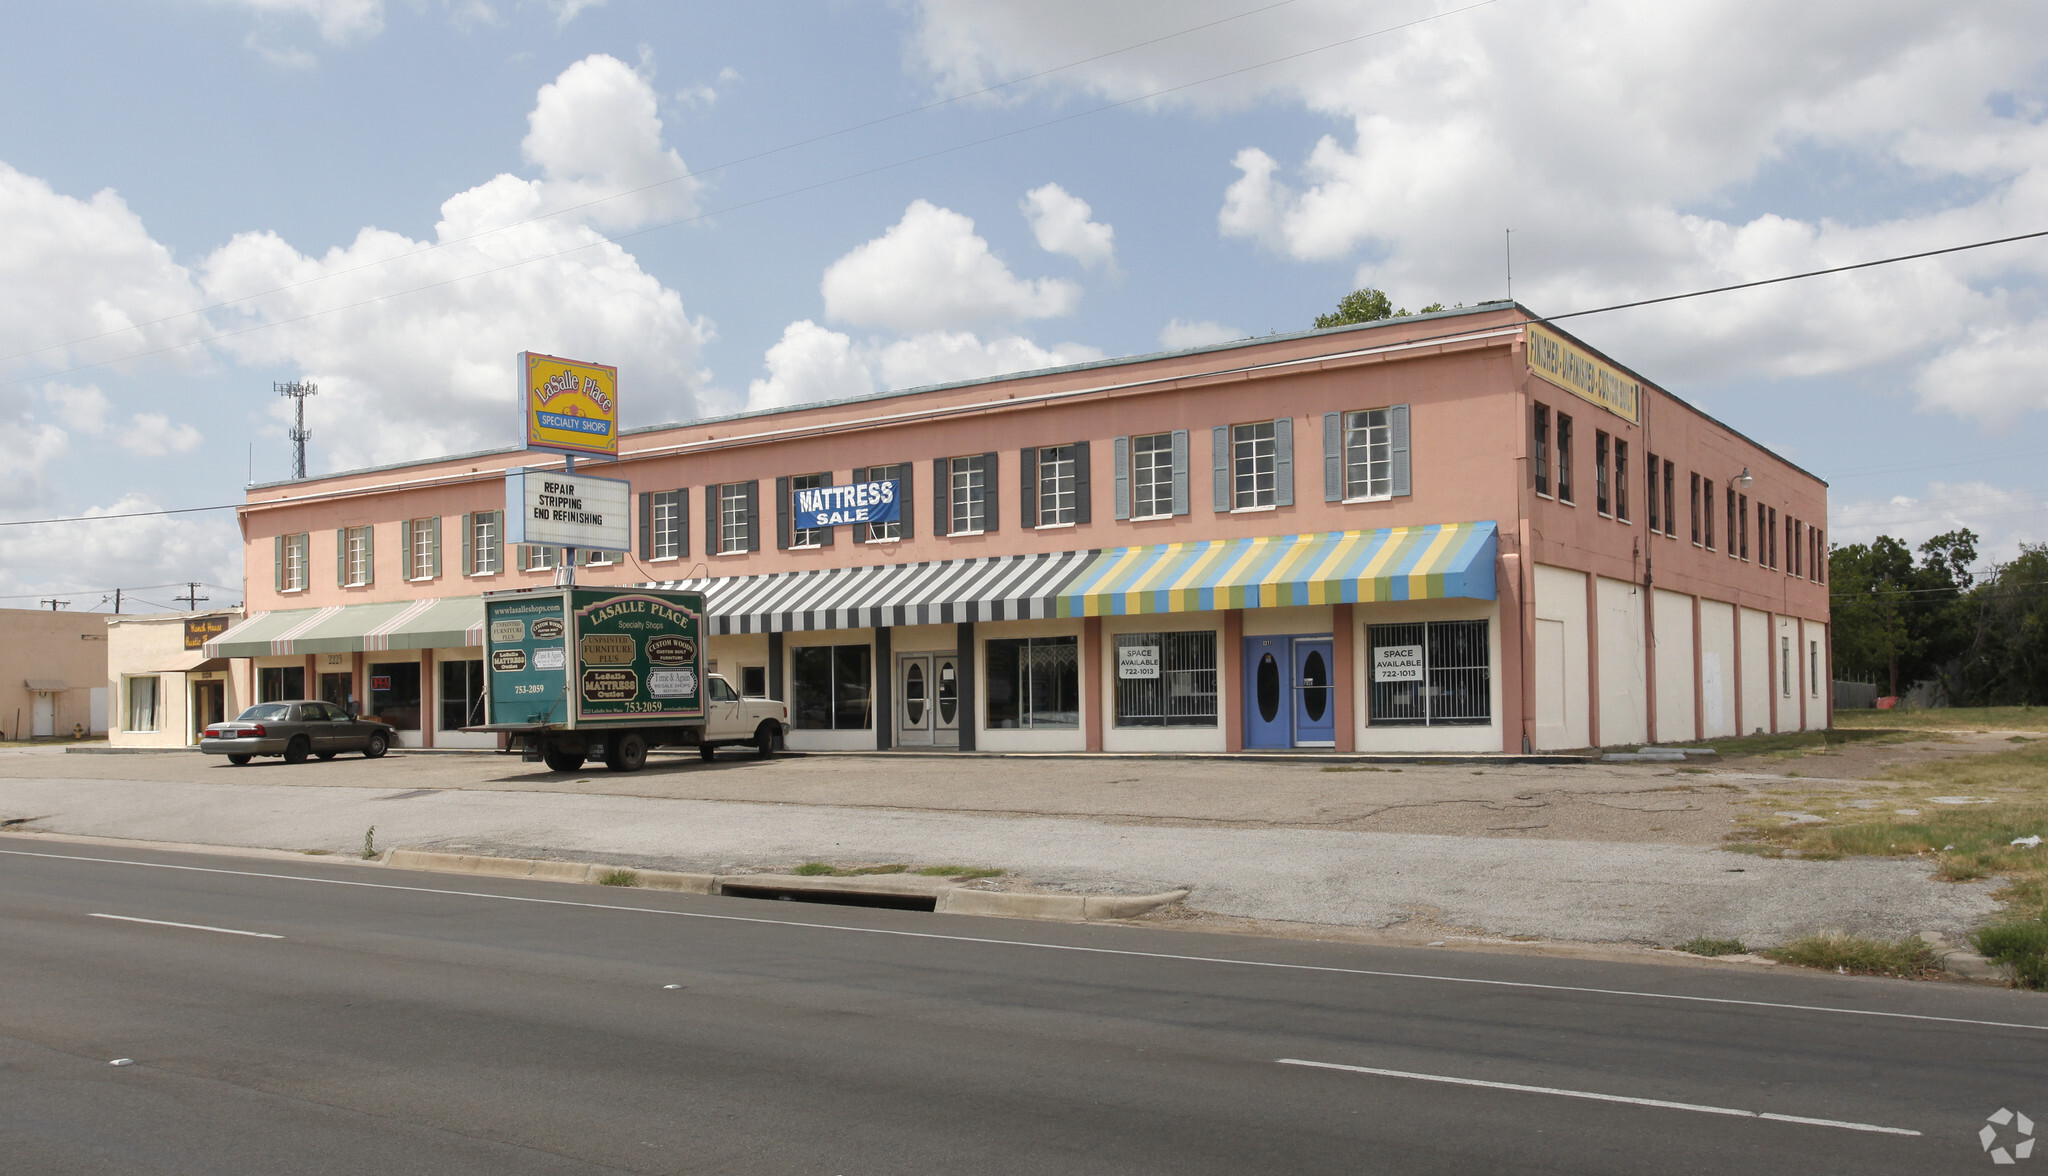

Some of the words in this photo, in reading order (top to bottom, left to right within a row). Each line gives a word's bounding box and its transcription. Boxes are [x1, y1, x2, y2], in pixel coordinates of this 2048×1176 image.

[1530, 330, 1560, 375] FINISHED
[1562, 347, 1596, 395] UNFINISHED
[1598, 367, 1619, 408] CUSTOM
[1619, 380, 1634, 414] BUILT
[535, 370, 580, 404] LaSalle
[582, 376, 612, 412] Place
[542, 415, 580, 428] SPECIALTY
[582, 421, 606, 432] SHOPS
[544, 482, 574, 495] REPAIR
[539, 494, 582, 509] STRIPPING
[799, 481, 894, 513] MATTRESS
[534, 507, 549, 520] END
[553, 510, 602, 525] REFINISHING
[816, 508, 869, 525] SALE
[590, 601, 646, 626] LASALLE
[651, 603, 689, 629] PLACE
[191, 621, 206, 632] Ranch
[618, 620, 644, 630] Specialty
[645, 621, 664, 630] Shops
[584, 645, 632, 653] FURNITURE
[648, 639, 672, 652] CUSTOM
[673, 639, 694, 653] WOODS
[328, 655, 343, 664] 2223
[599, 655, 619, 663] PLUS
[1384, 650, 1413, 658] SPACE
[494, 657, 525, 665] MATTRESS
[1377, 660, 1421, 668] AVAILABLE
[655, 673, 669, 682] Time
[670, 673, 675, 681] &
[675, 673, 691, 683] Again
[1382, 670, 1416, 678] 722-1013
[371, 677, 391, 689] OPEN
[585, 681, 636, 691] MATTRESS
[515, 684, 545, 694] 753-2059
[624, 701, 663, 713] 753-2059
